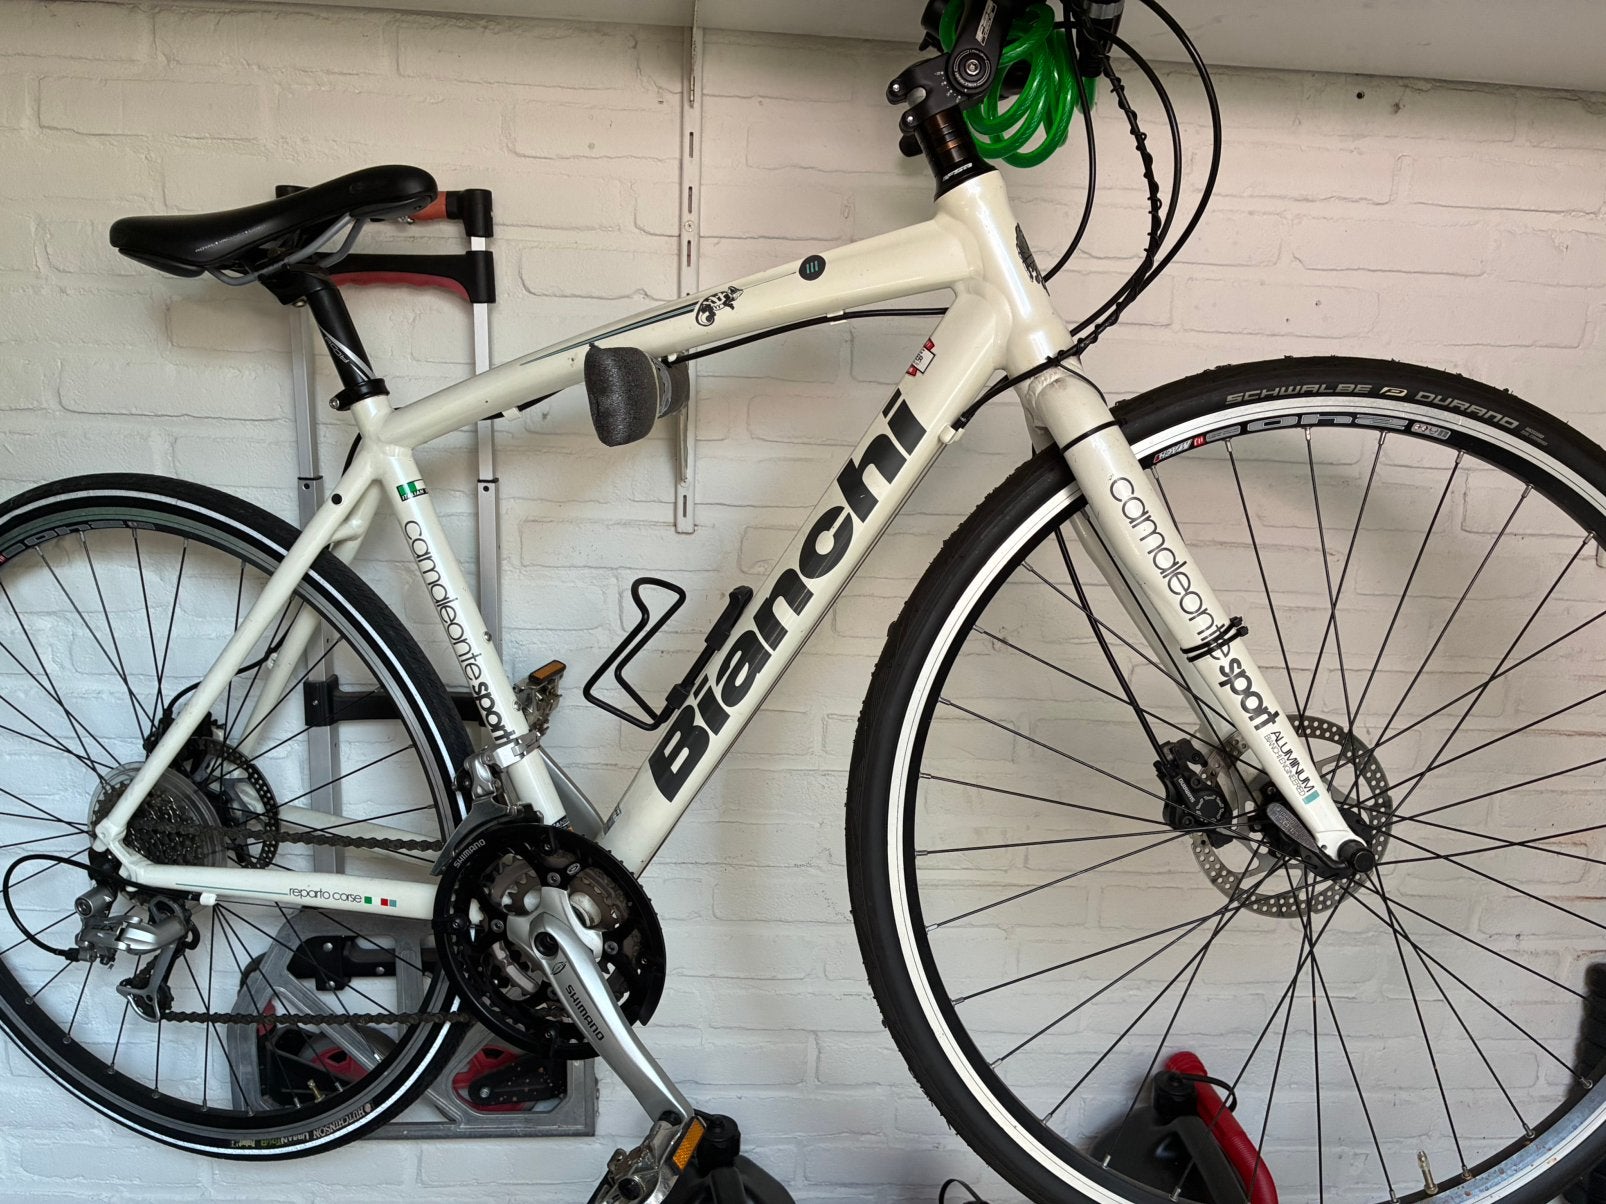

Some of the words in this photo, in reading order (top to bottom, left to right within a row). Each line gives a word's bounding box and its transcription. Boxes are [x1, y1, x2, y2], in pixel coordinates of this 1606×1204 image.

[1225, 384, 1372, 404] SCHWALBE
[1414, 391, 1519, 429] DURANO
[648, 387, 927, 802] Bianchi
[1110, 477, 1231, 660] camaleonte
[1218, 657, 1280, 731] sport
[404, 520, 482, 681] camaleonte
[472, 680, 516, 744] sport
[1270, 730, 1315, 793] ALUMINUM
[453, 838, 486, 869] SHIMANO
[289, 887, 331, 900] reparto
[332, 891, 362, 903] corse
[565, 984, 605, 1041] SHIMANO
[312, 1105, 365, 1138] HUTCHINSON
